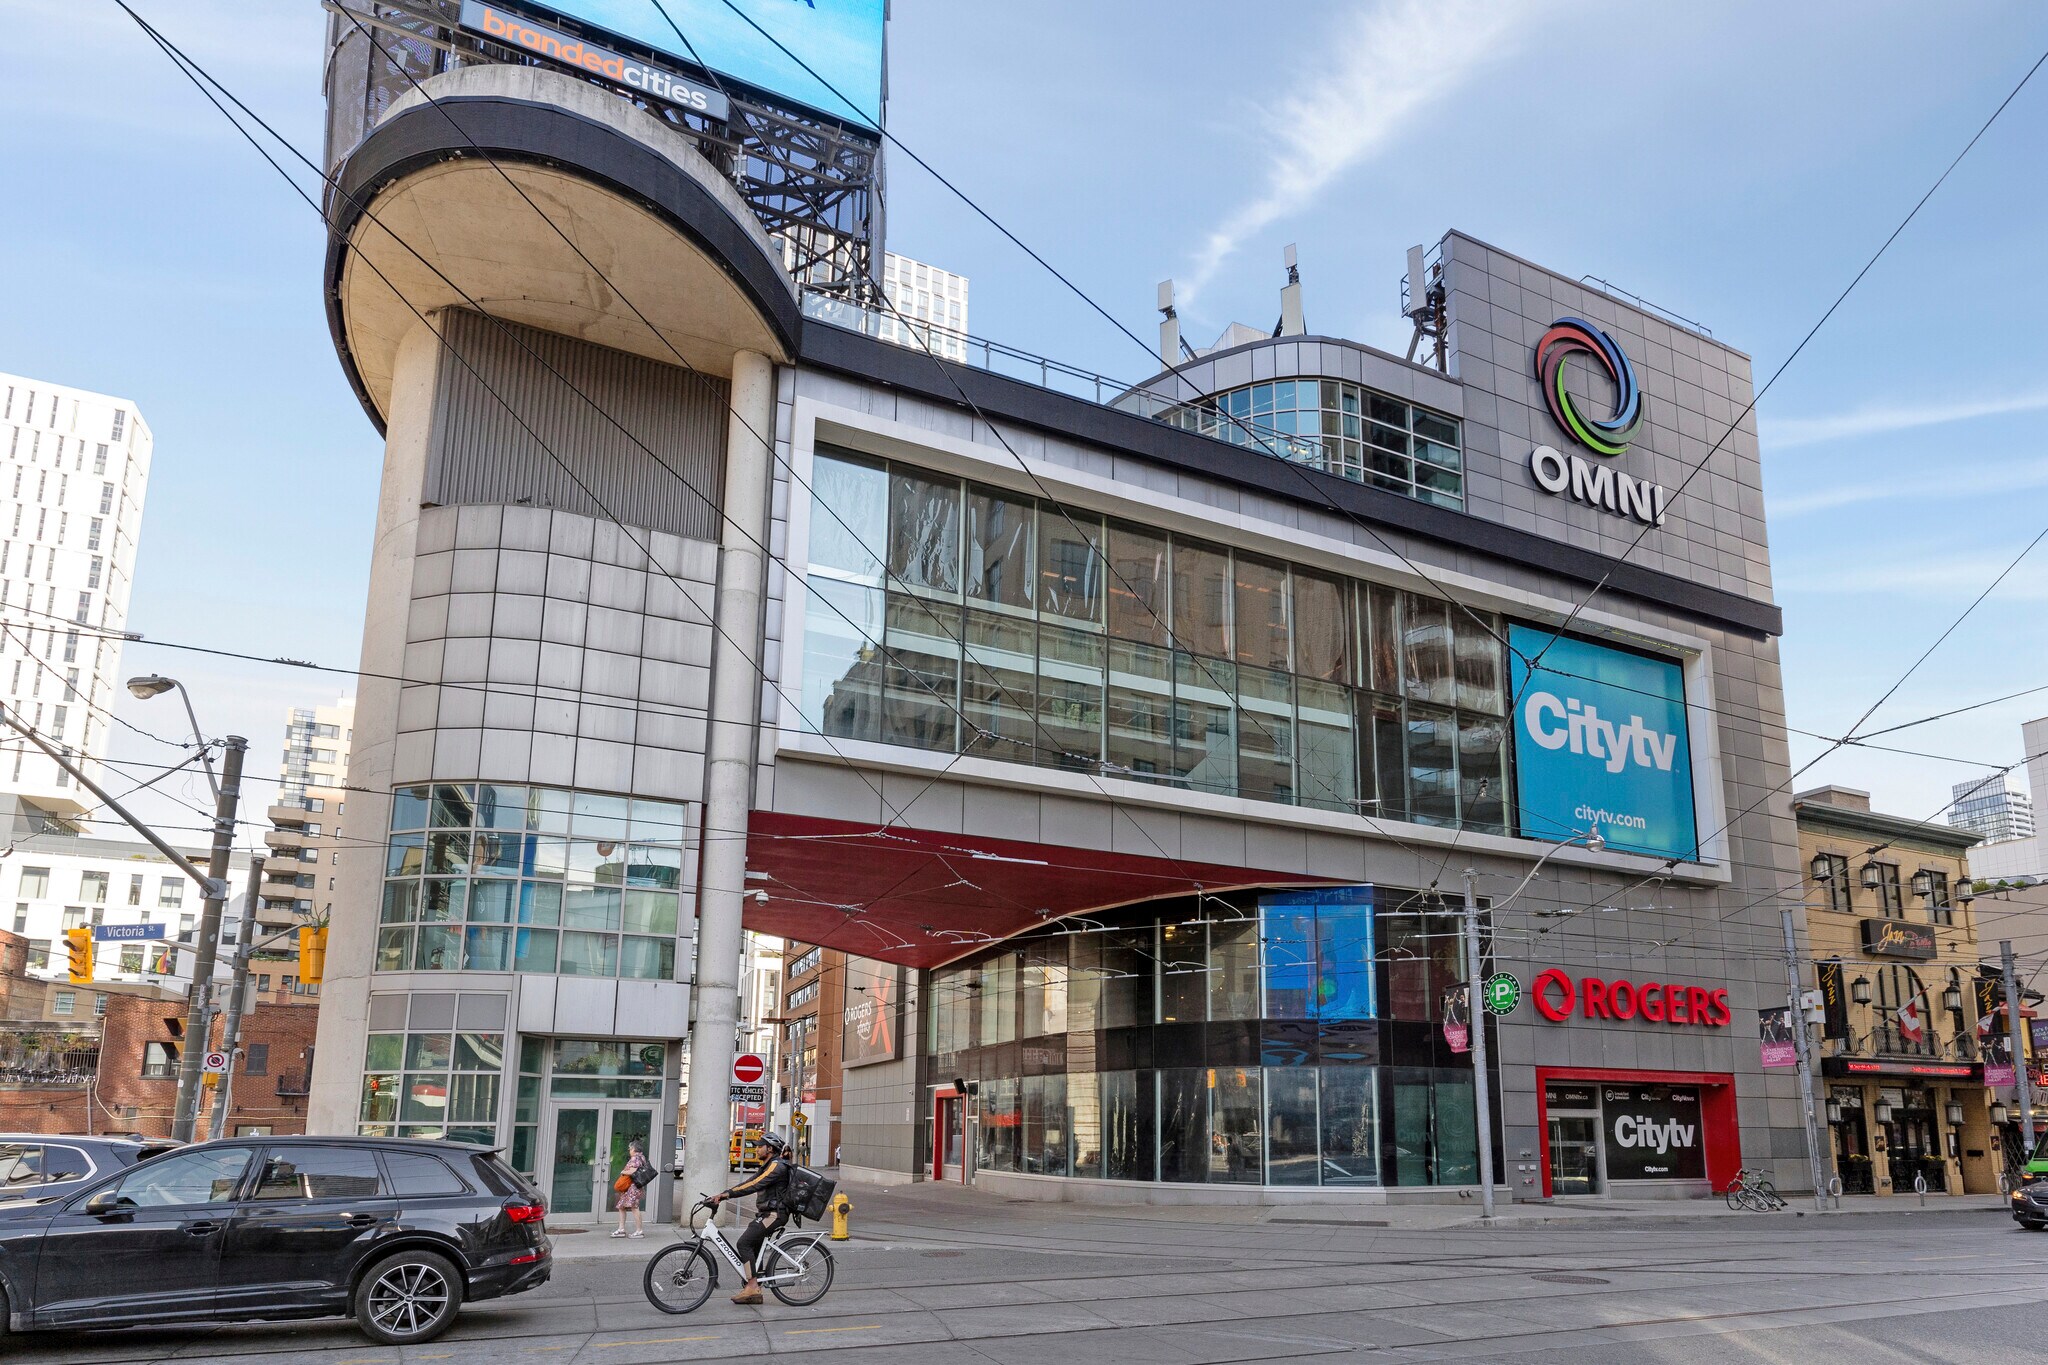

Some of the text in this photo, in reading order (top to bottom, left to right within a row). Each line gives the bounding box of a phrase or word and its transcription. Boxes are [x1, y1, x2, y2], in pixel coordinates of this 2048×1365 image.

[483, 8, 707, 111] brandedcities
[1530, 445, 1666, 526] OMNI
[1525, 691, 1677, 774] Citytv
[1574, 804, 1647, 830] citytv.com
[106, 925, 145, 938] Victoria
[1485, 973, 1519, 995] MUNICIPAL
[1495, 983, 1510, 1001] P
[850, 1001, 872, 1021] ROGERS
[1485, 996, 1519, 1015] PARKING
[1581, 977, 1731, 1027] ROGERS
[1614, 1114, 1694, 1155] Citytv
[720, 1243, 742, 1267] zoomo
